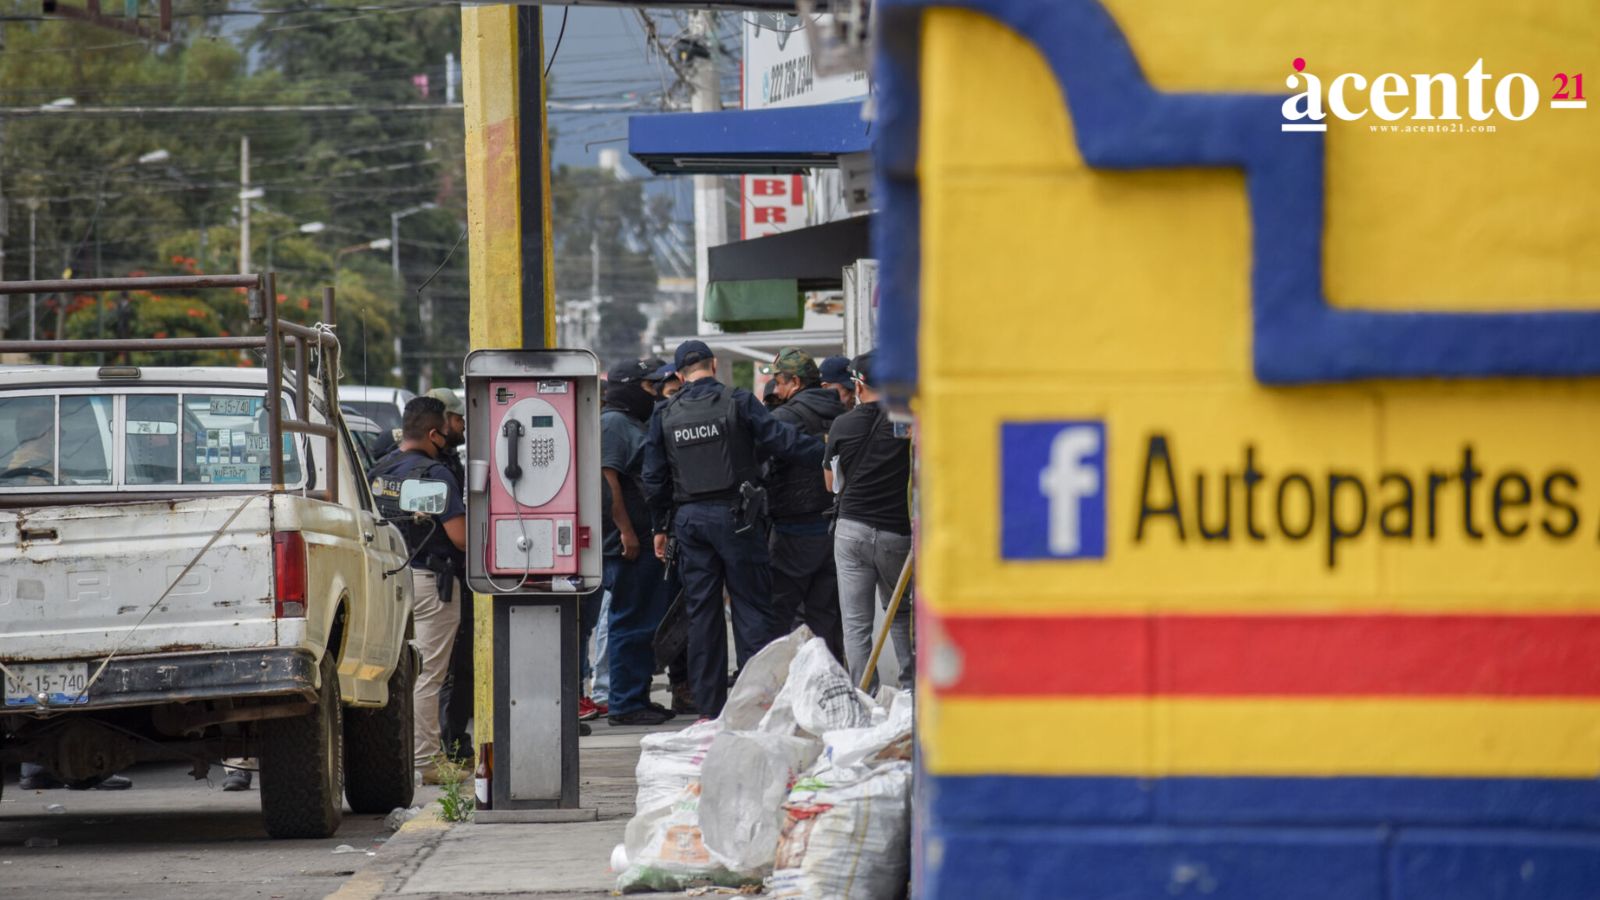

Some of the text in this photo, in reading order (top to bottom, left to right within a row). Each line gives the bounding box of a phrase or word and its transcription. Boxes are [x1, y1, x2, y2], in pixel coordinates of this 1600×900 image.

[674, 423, 720, 443] POLICIA
[1134, 433, 1581, 570] Autopartes
[7, 674, 84, 694] SK-15-740
